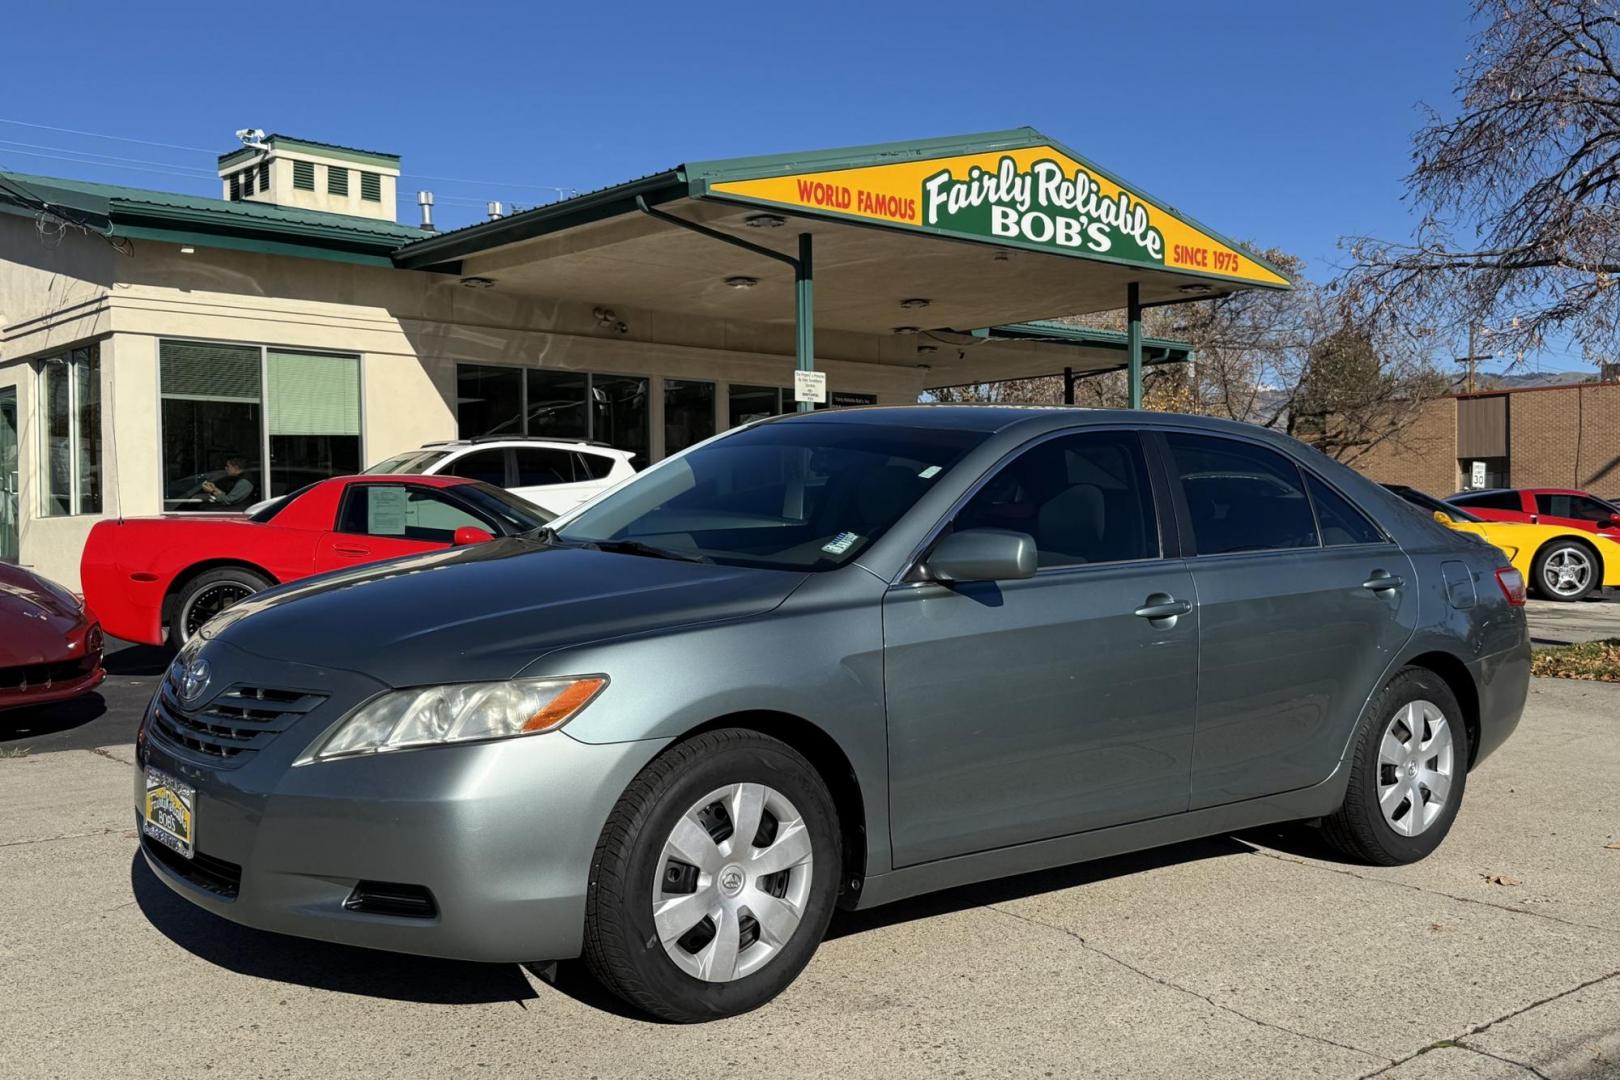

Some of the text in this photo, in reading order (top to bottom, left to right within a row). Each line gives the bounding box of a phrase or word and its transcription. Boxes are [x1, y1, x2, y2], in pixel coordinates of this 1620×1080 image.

[796, 178, 916, 221] WORLD FAMOUS
[925, 159, 1163, 260] Fairly Reliable
[991, 204, 1112, 253] BOB'S
[1173, 244, 1239, 273] SINCE 1975
[1473, 475, 1484, 485] 30
